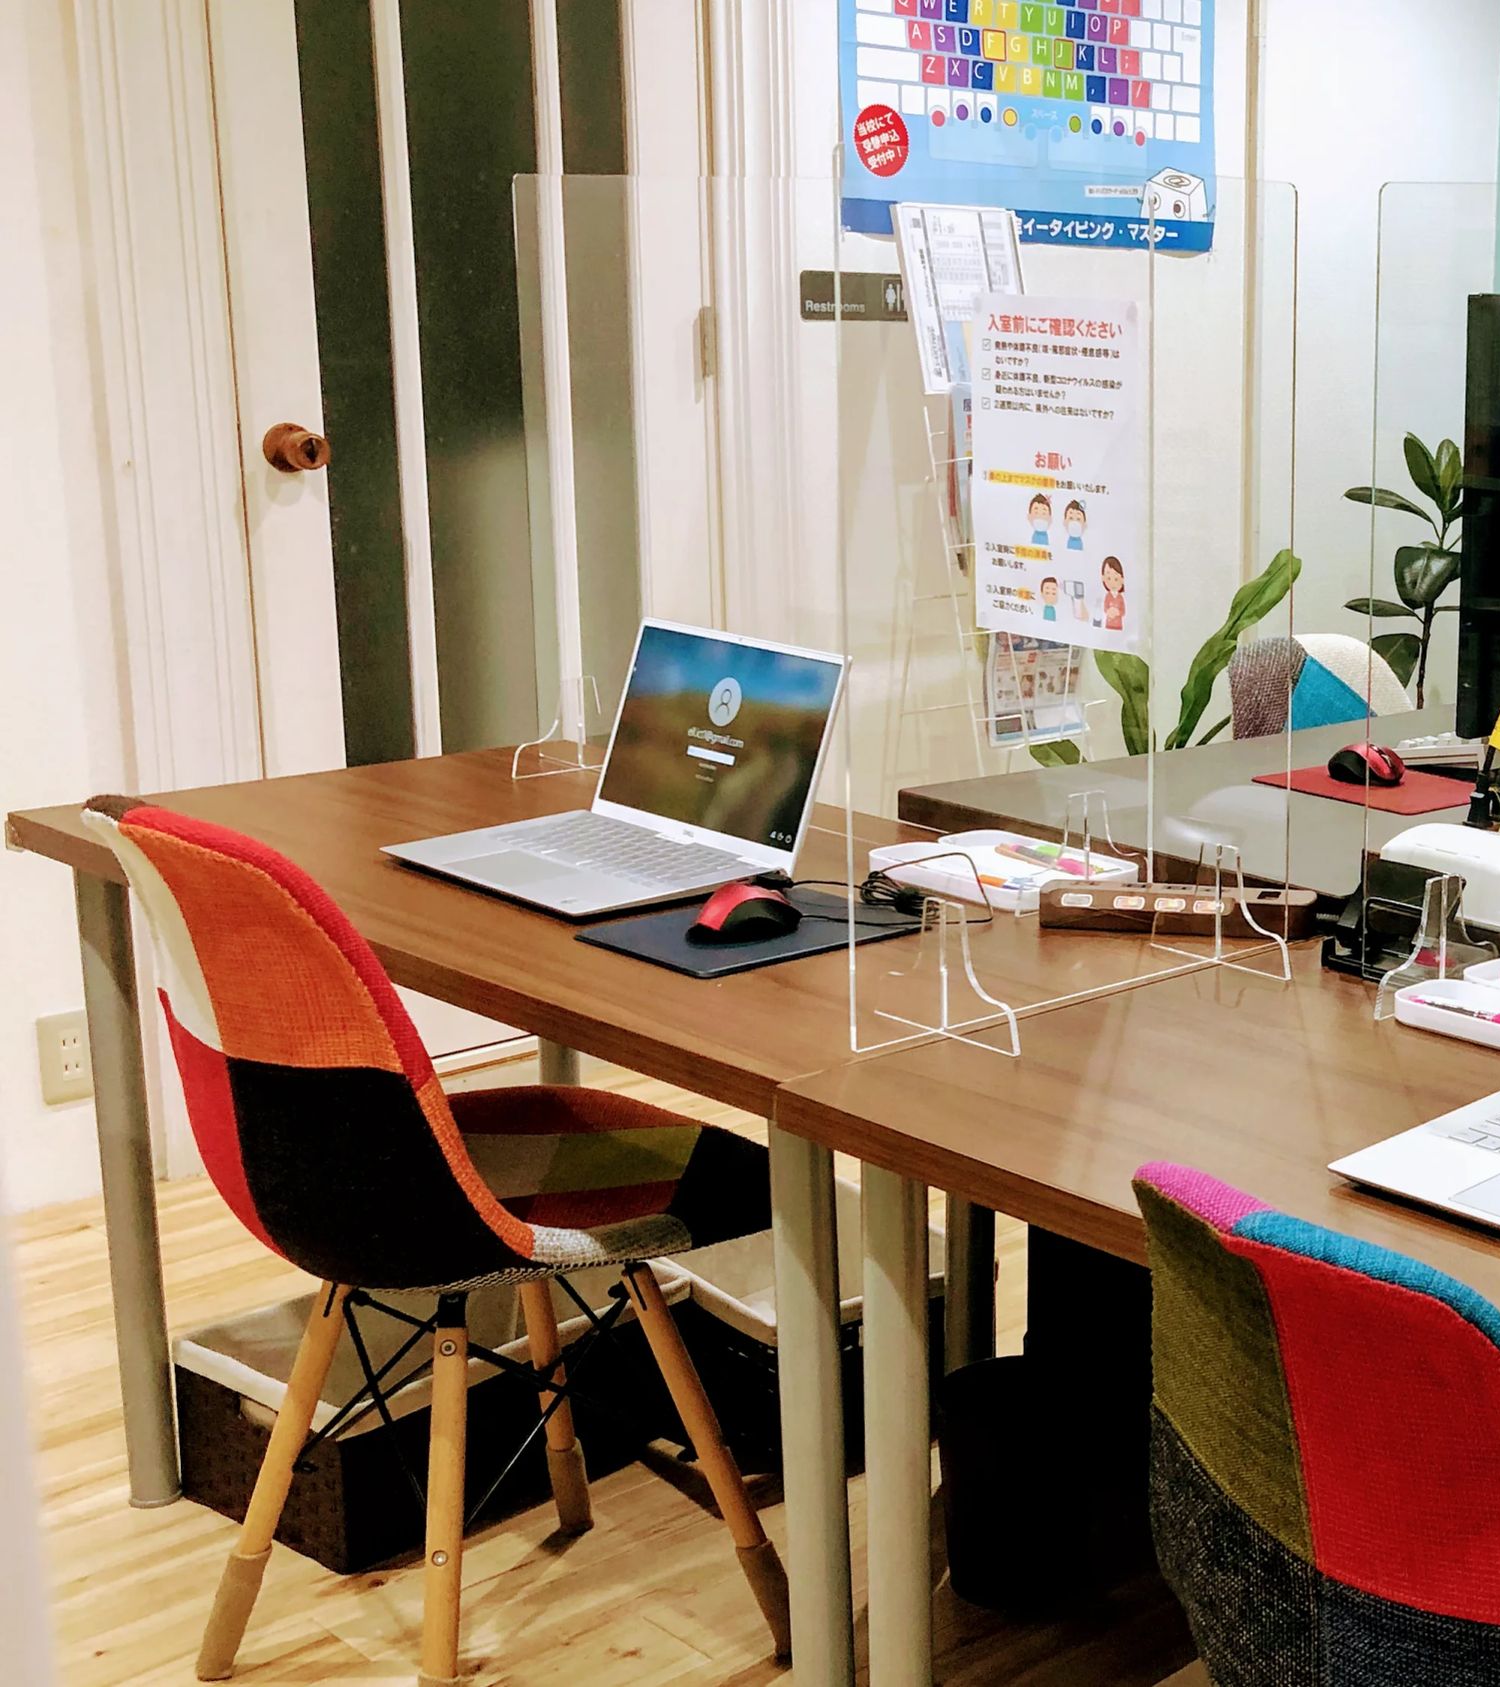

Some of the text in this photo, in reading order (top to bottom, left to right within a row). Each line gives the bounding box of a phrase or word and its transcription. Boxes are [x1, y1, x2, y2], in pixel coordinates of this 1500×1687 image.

[1000, 3, 1009, 19] T
[1025, 7, 1034, 23] Y
[1047, 11, 1056, 26] U
[1090, 16, 1100, 32] O
[1113, 19, 1122, 35] P
[911, 23, 922, 40] A
[938, 26, 946, 43] S
[962, 29, 973, 46] D
[987, 32, 995, 49] F
[1010, 36, 1020, 53] G
[1036, 40, 1047, 55] H
[1078, 46, 1087, 61] K
[1101, 48, 1108, 64] L
[925, 56, 936, 74] Z
[951, 60, 960, 77] X
[974, 63, 984, 79] C
[999, 66, 1008, 82] V
[1023, 68, 1032, 84] B
[1046, 72, 1055, 87] N
[1066, 74, 1078, 91] M
[805, 299, 866, 313] Restroms
[1034, 451, 1073, 471] お願い
